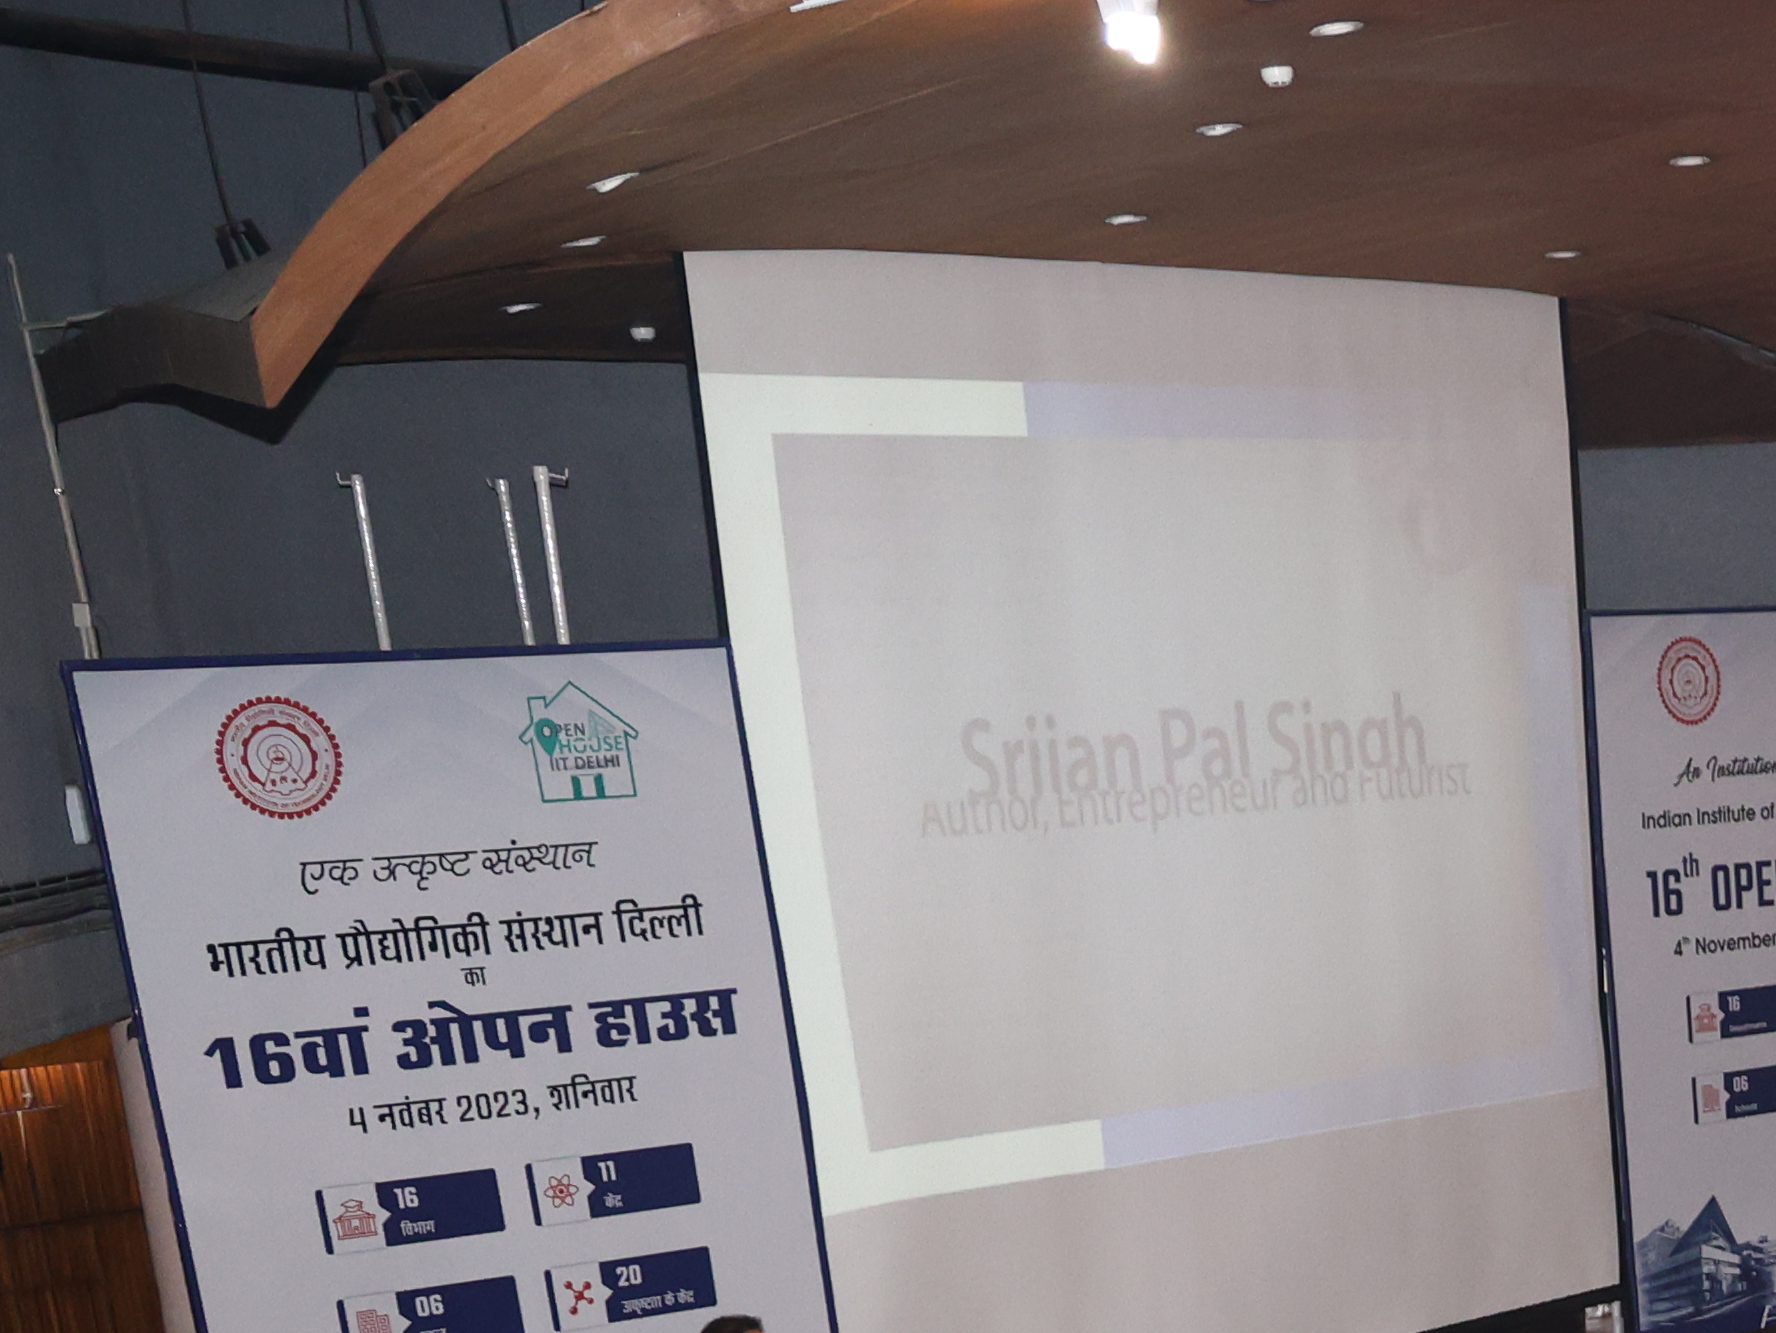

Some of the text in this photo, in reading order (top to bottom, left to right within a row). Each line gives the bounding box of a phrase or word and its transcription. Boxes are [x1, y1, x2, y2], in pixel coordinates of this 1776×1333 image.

[542, 722, 587, 738] OPEN
[1157, 699, 1251, 784] Pal
[559, 736, 625, 754] HOUSE
[549, 754, 621, 771] IIT DELHI
[1673, 756, 1702, 788] An
[1641, 811, 1693, 830] Indian
[1696, 804, 1756, 826] Institute
[1760, 801, 1775, 821] of
[300, 839, 599, 894] एक उत्कृष्ट संस्थान
[1645, 852, 1700, 918] 16th
[207, 894, 706, 978] भारतीय प्रौद्योगिकी संस्थान दिल्ली
[461, 966, 487, 988] का
[1726, 994, 1741, 1012] 16
[203, 987, 738, 1090] 16वां ओपन हाउस
[1732, 1075, 1749, 1092] 06
[374, 1096, 448, 1132] नवंबर
[458, 1088, 541, 1124] 2023,
[547, 1072, 638, 1112] शनिवार
[597, 1160, 618, 1182] 11
[393, 1186, 420, 1210] 16
[400, 1220, 436, 1237] विभाग
[615, 1264, 643, 1287] 20
[414, 1293, 445, 1317] 06
